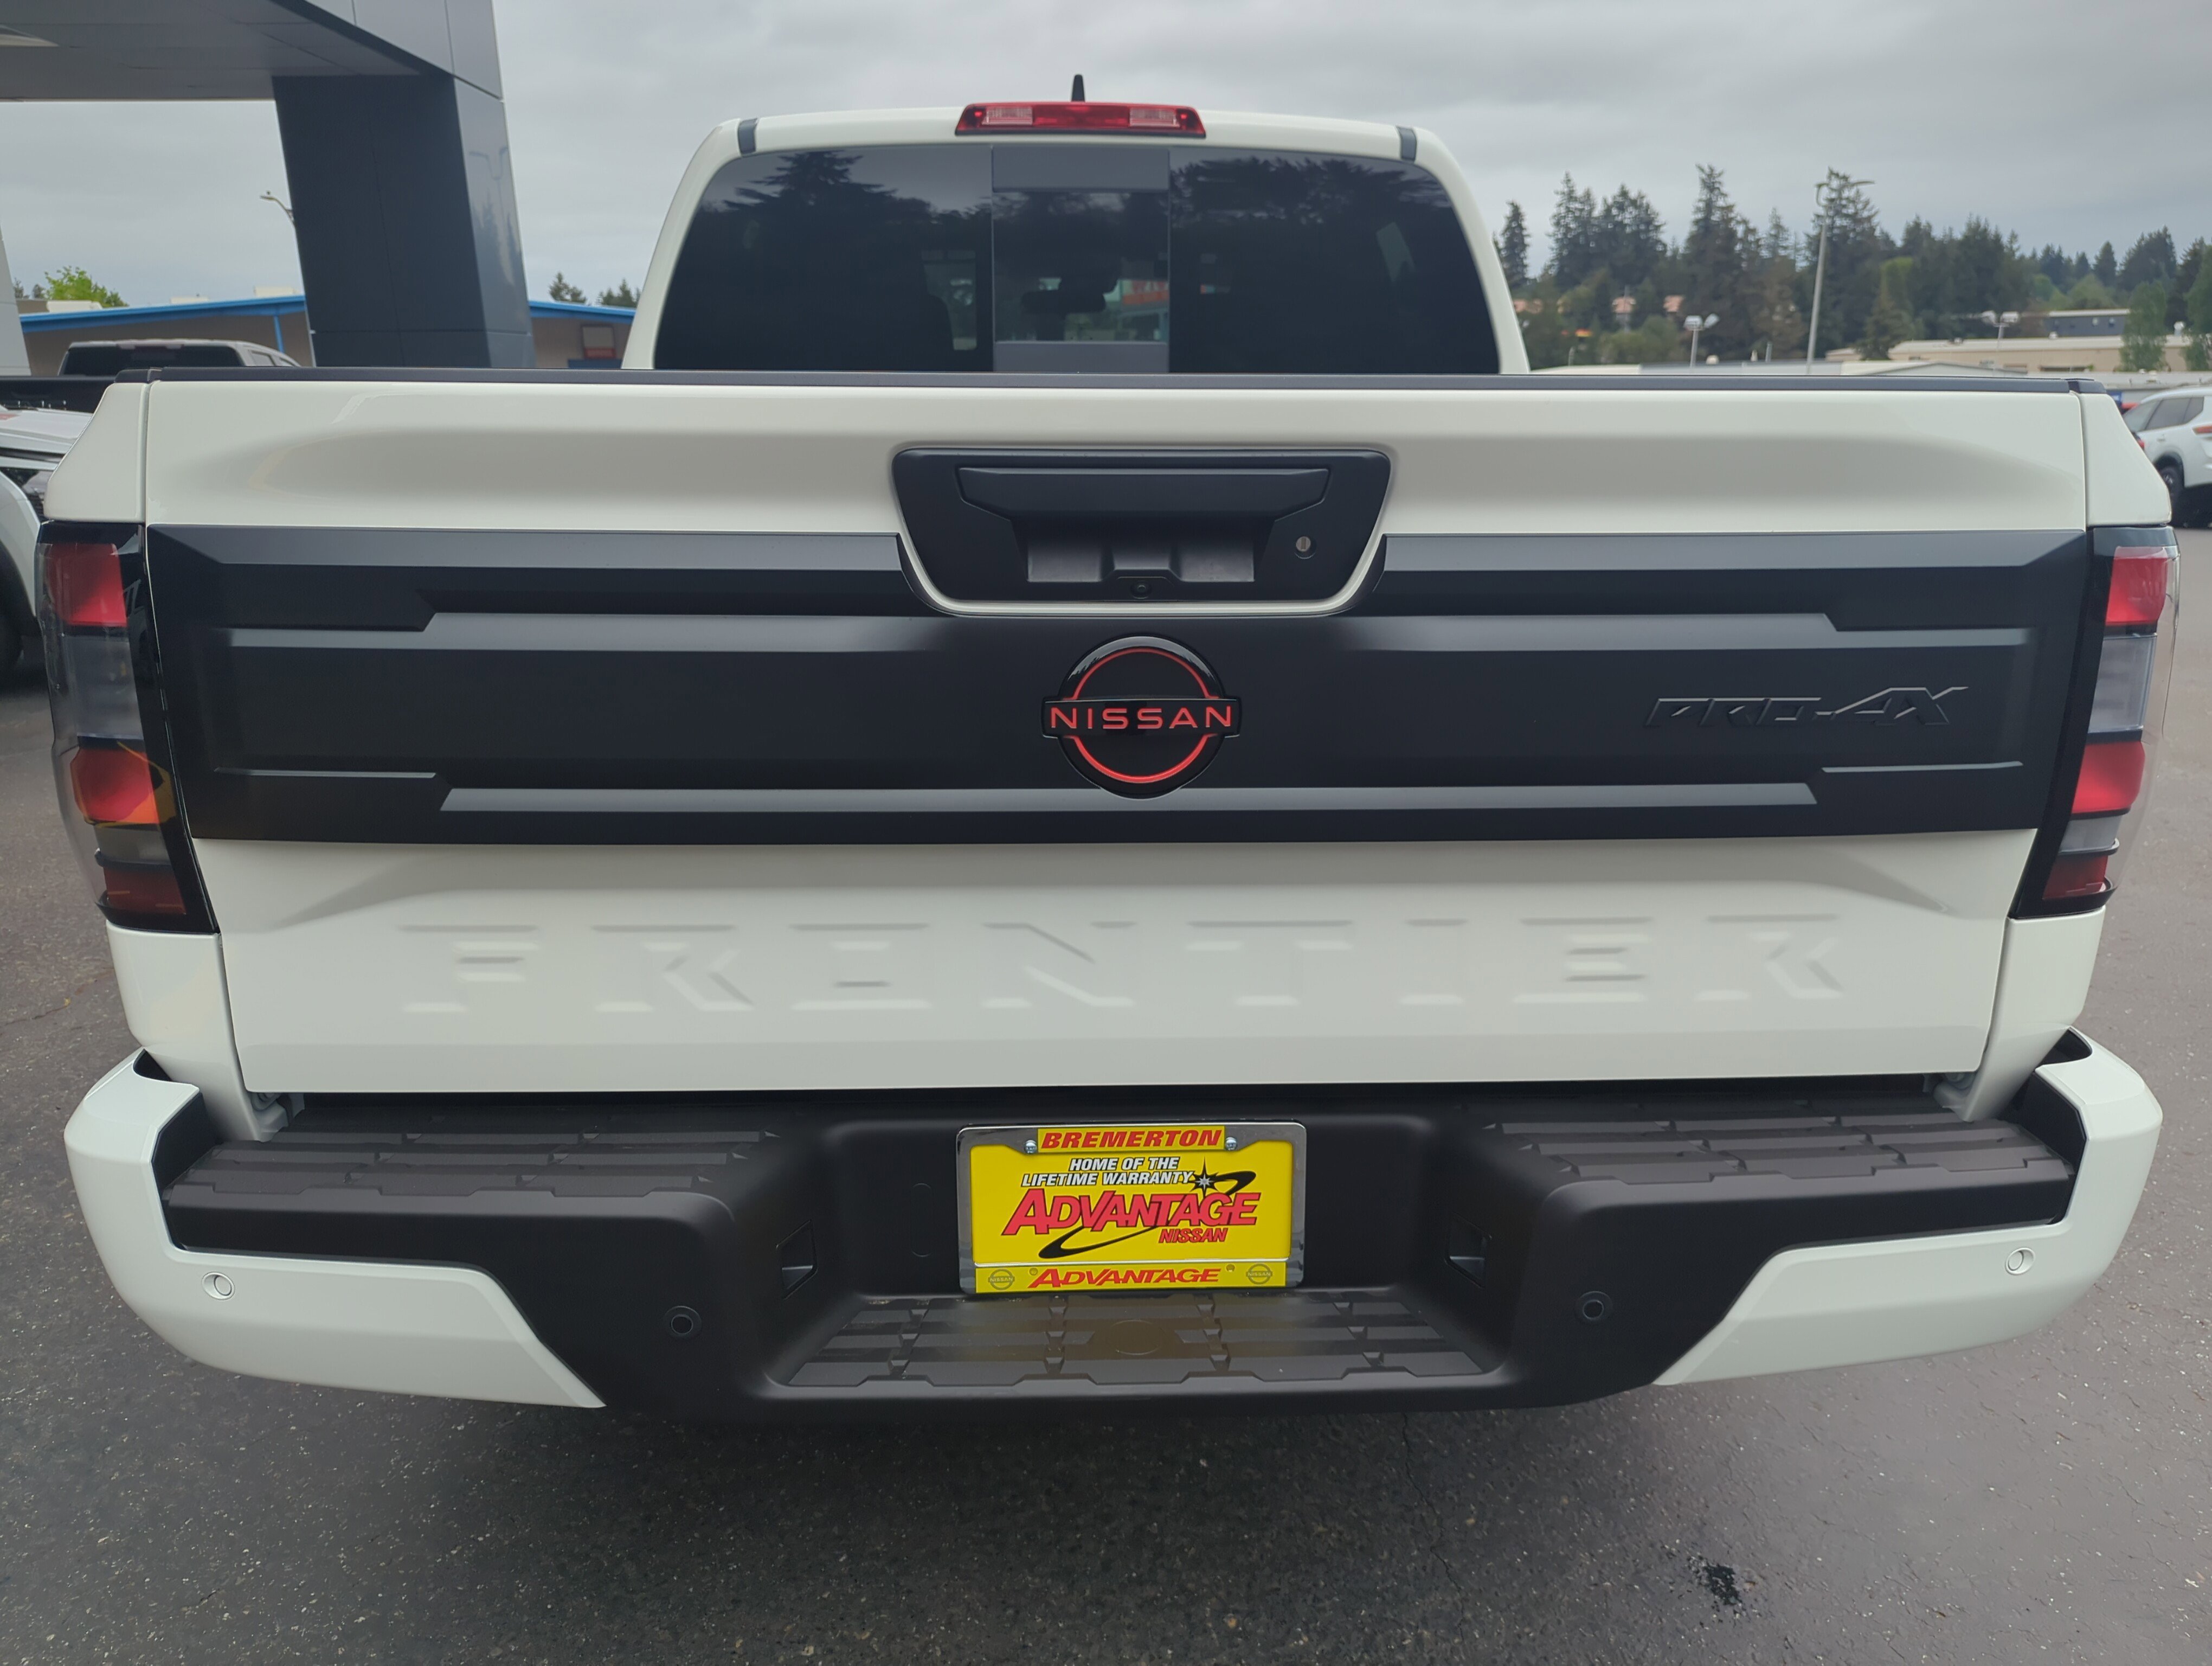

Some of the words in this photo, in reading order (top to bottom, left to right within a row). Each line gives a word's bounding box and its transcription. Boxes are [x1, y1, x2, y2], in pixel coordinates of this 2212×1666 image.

[1050, 706, 1231, 729] NISSAN
[1643, 687, 1969, 727] PRO-4X
[396, 913, 1845, 1015] FRONTIER
[1040, 1129, 1223, 1149] BREMERTON
[1068, 1158, 1118, 1171] HOME
[1121, 1157, 1143, 1170] OF
[1148, 1156, 1181, 1170] THE
[1021, 1172, 1099, 1187] LIFETIME
[1102, 1170, 1195, 1185] WARRANTY
[1001, 1188, 1261, 1236] ADVANTAGE
[1158, 1227, 1229, 1244] NISSAN
[1027, 1268, 1221, 1289] ADVANTAGE
